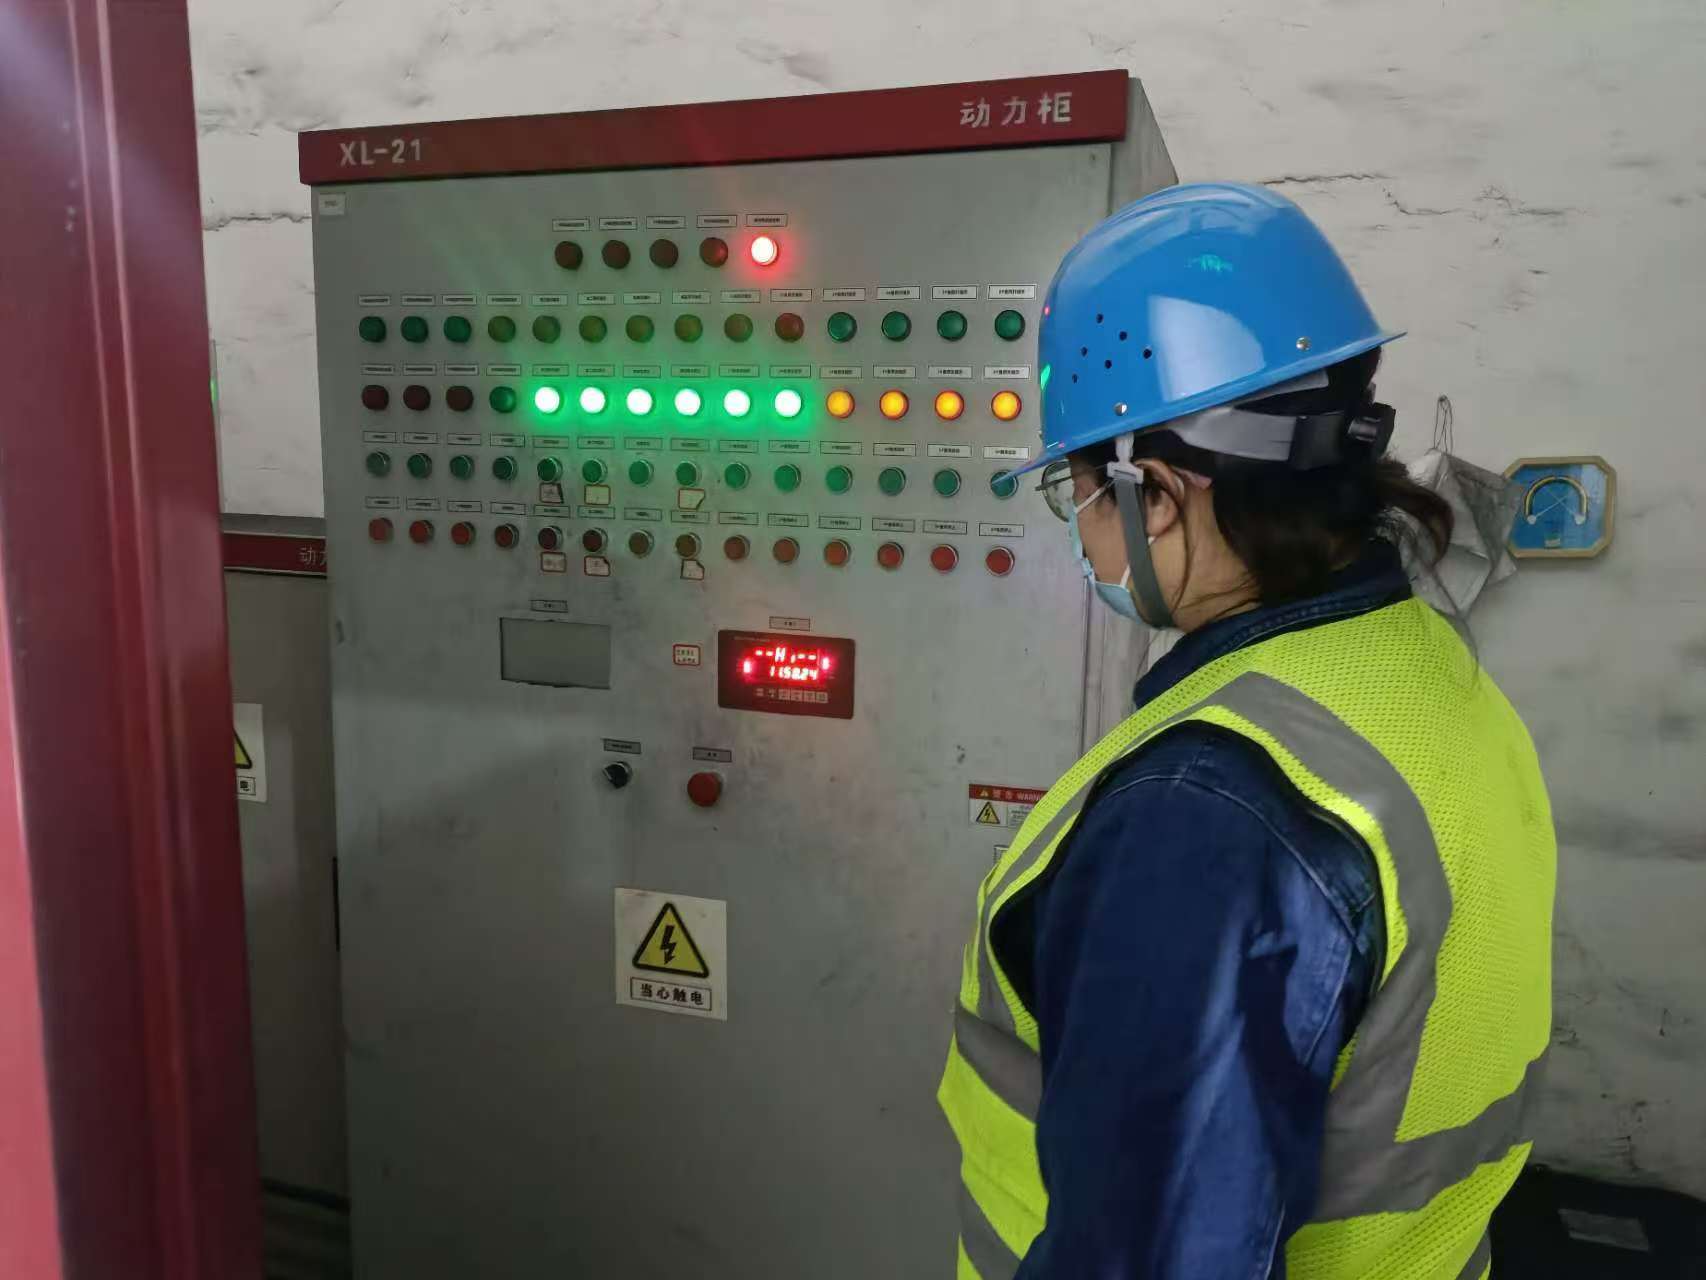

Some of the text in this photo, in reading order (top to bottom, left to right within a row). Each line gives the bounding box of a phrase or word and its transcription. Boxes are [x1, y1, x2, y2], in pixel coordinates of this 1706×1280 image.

[959, 92, 1073, 128] 动力柜
[339, 139, 421, 168] XL-21
[640, 983, 704, 1006] 当心触电
